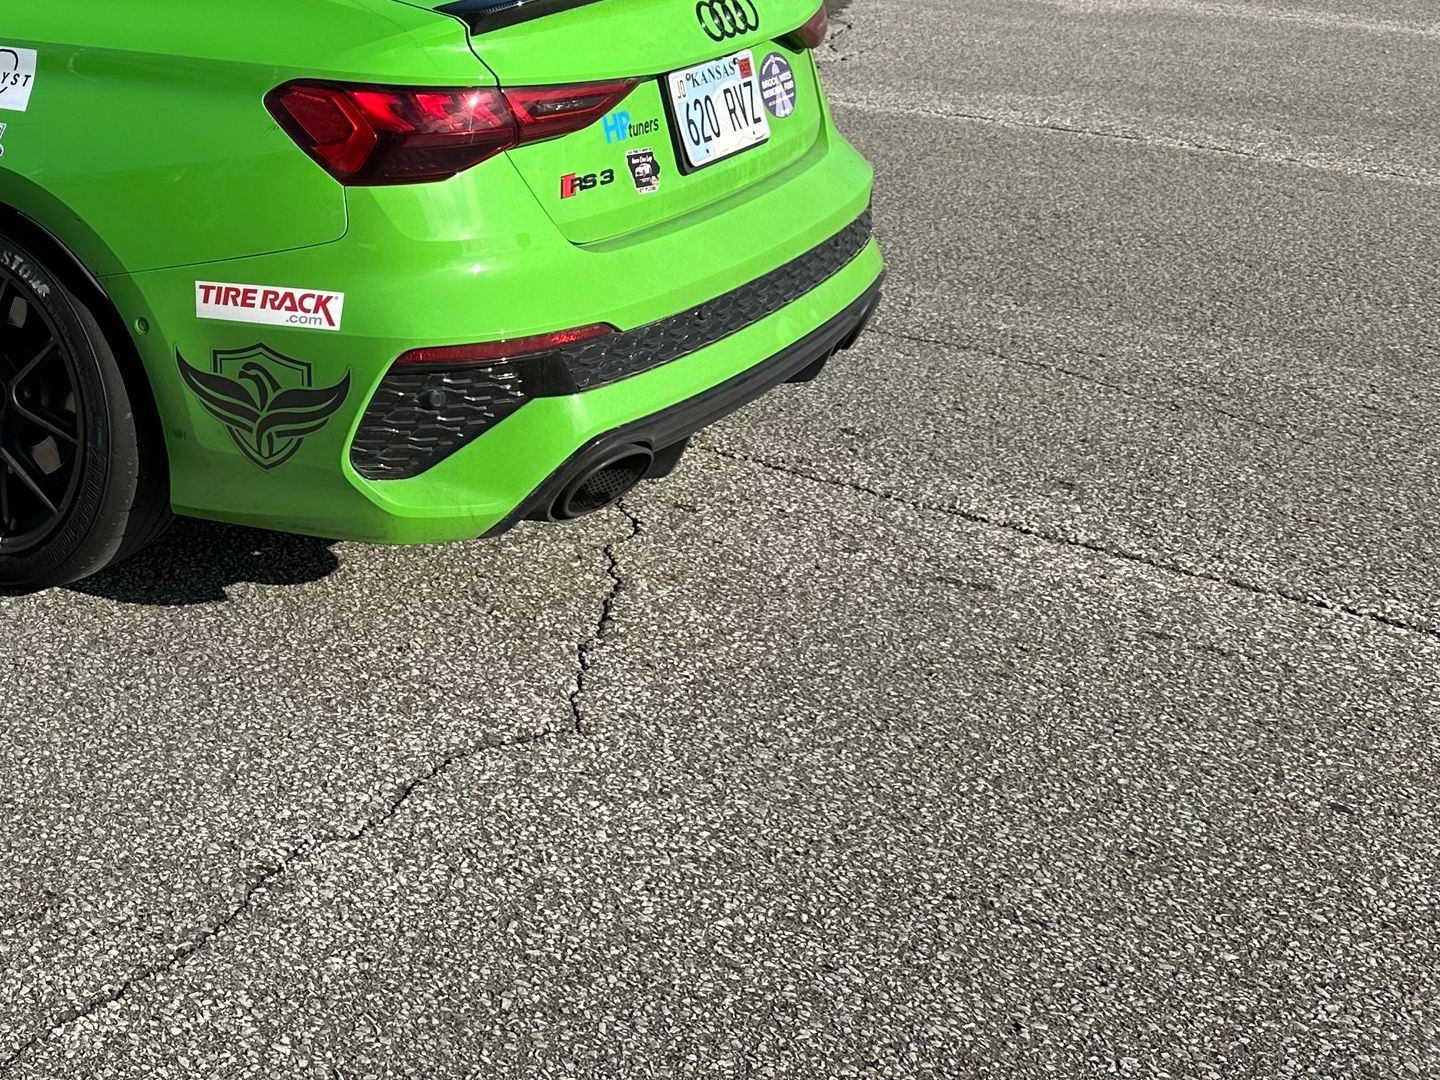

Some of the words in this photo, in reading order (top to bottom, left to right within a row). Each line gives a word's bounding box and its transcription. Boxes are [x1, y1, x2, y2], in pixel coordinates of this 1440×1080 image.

[690, 59, 736, 88] KANSAS
[602, 110, 631, 144] HP
[628, 119, 660, 138] tuners
[686, 95, 720, 146] 620
[723, 80, 762, 132] RVZ
[599, 168, 615, 186] 3
[199, 284, 258, 309] TIRE
[260, 290, 336, 327] RACK
[285, 315, 323, 326] .com
